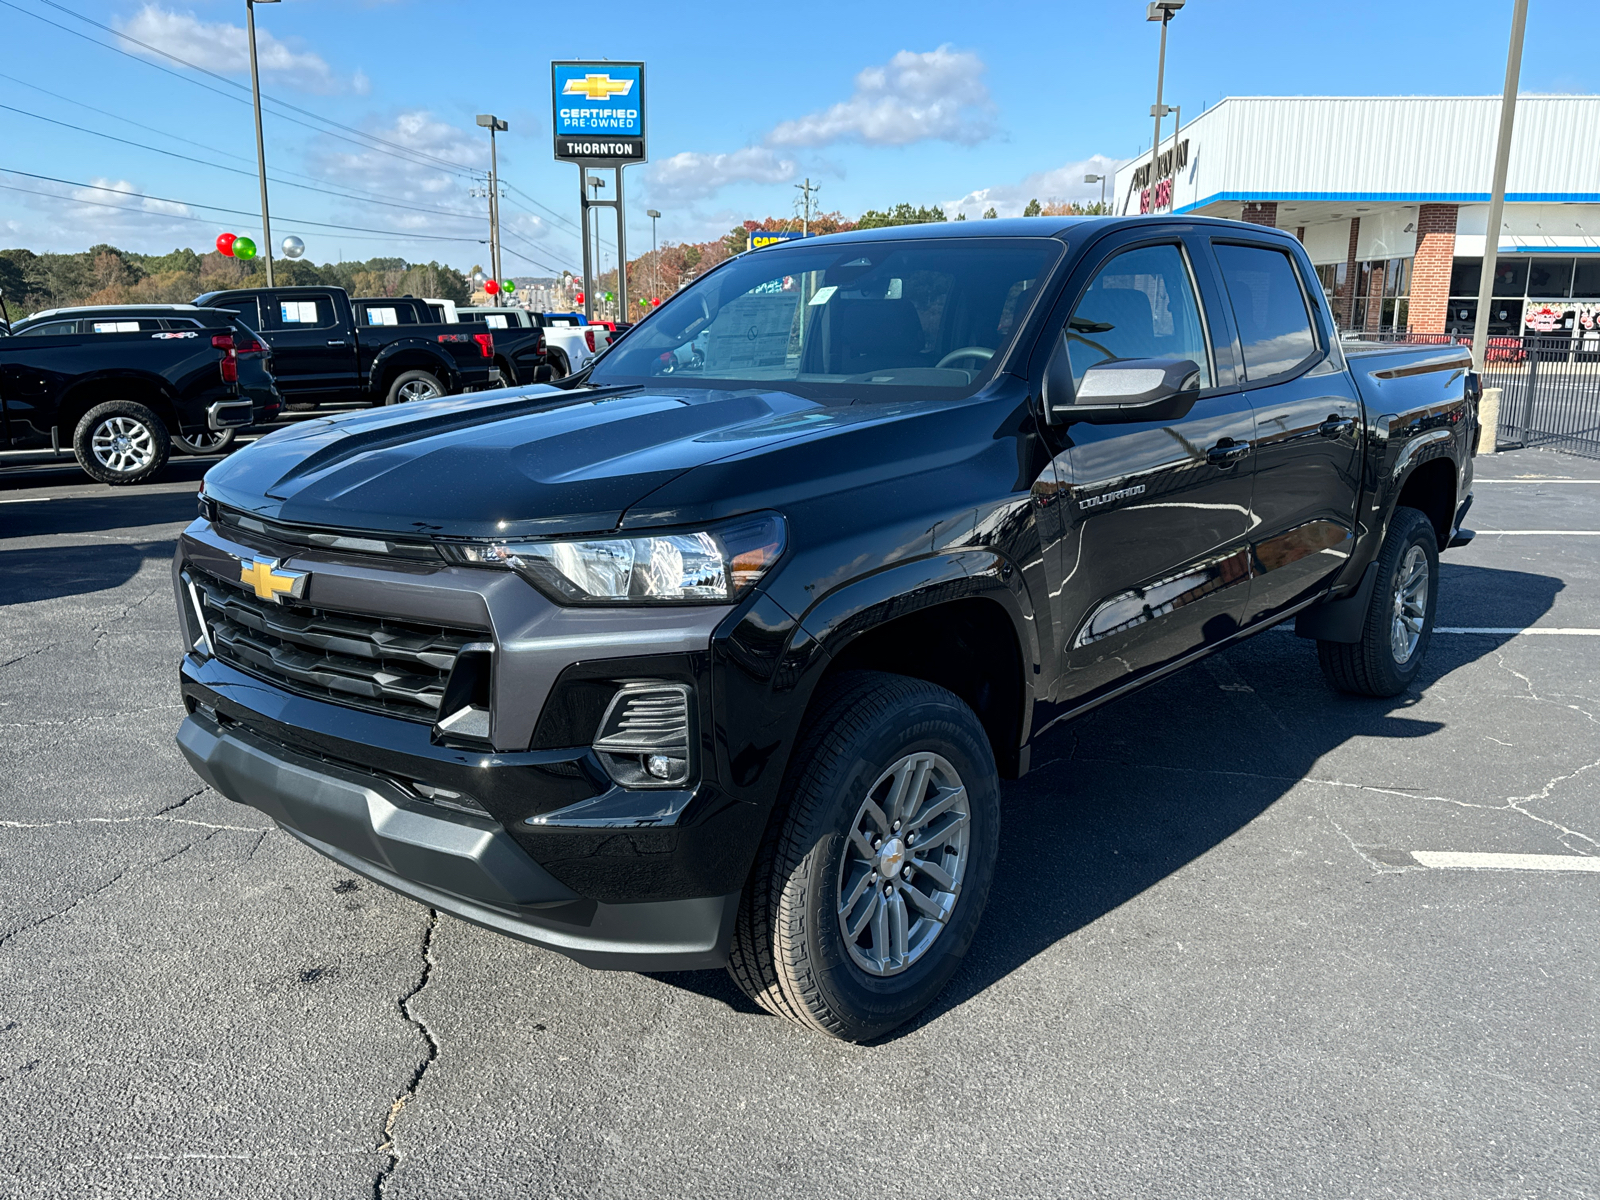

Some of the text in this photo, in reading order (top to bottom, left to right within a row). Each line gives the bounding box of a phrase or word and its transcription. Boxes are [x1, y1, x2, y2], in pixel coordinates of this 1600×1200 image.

[560, 109, 637, 118] CERTIFIED
[564, 119, 634, 128] PRE-OWNED
[567, 143, 632, 154] THORNTON
[438, 334, 468, 343] FX4
[1079, 484, 1146, 510] COLORADO
[897, 718, 962, 744] TERRITORY
